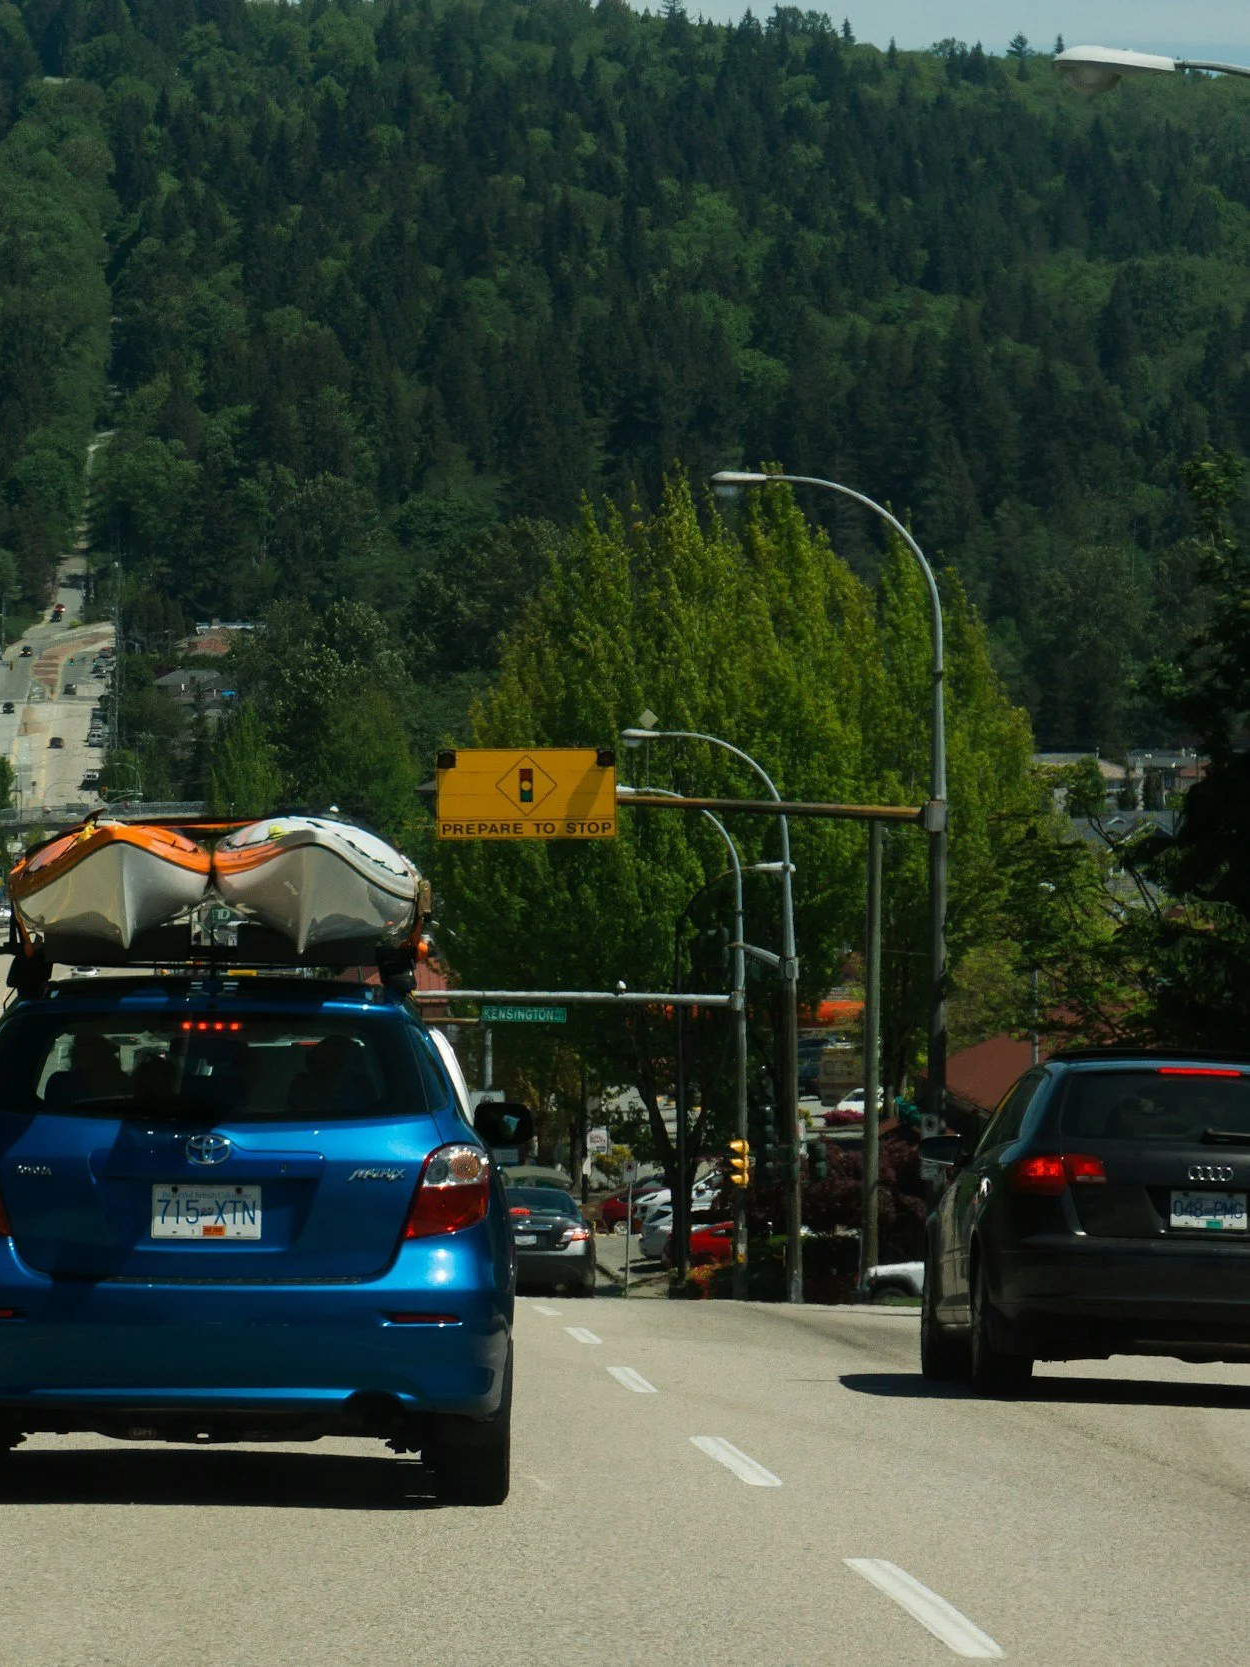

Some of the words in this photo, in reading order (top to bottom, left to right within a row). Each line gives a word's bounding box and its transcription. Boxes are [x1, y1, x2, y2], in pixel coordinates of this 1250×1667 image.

[442, 823, 523, 835] PREPARE
[535, 823, 555, 834] TO
[566, 822, 612, 834] STOP
[484, 1008, 554, 1020] KENSINGTON
